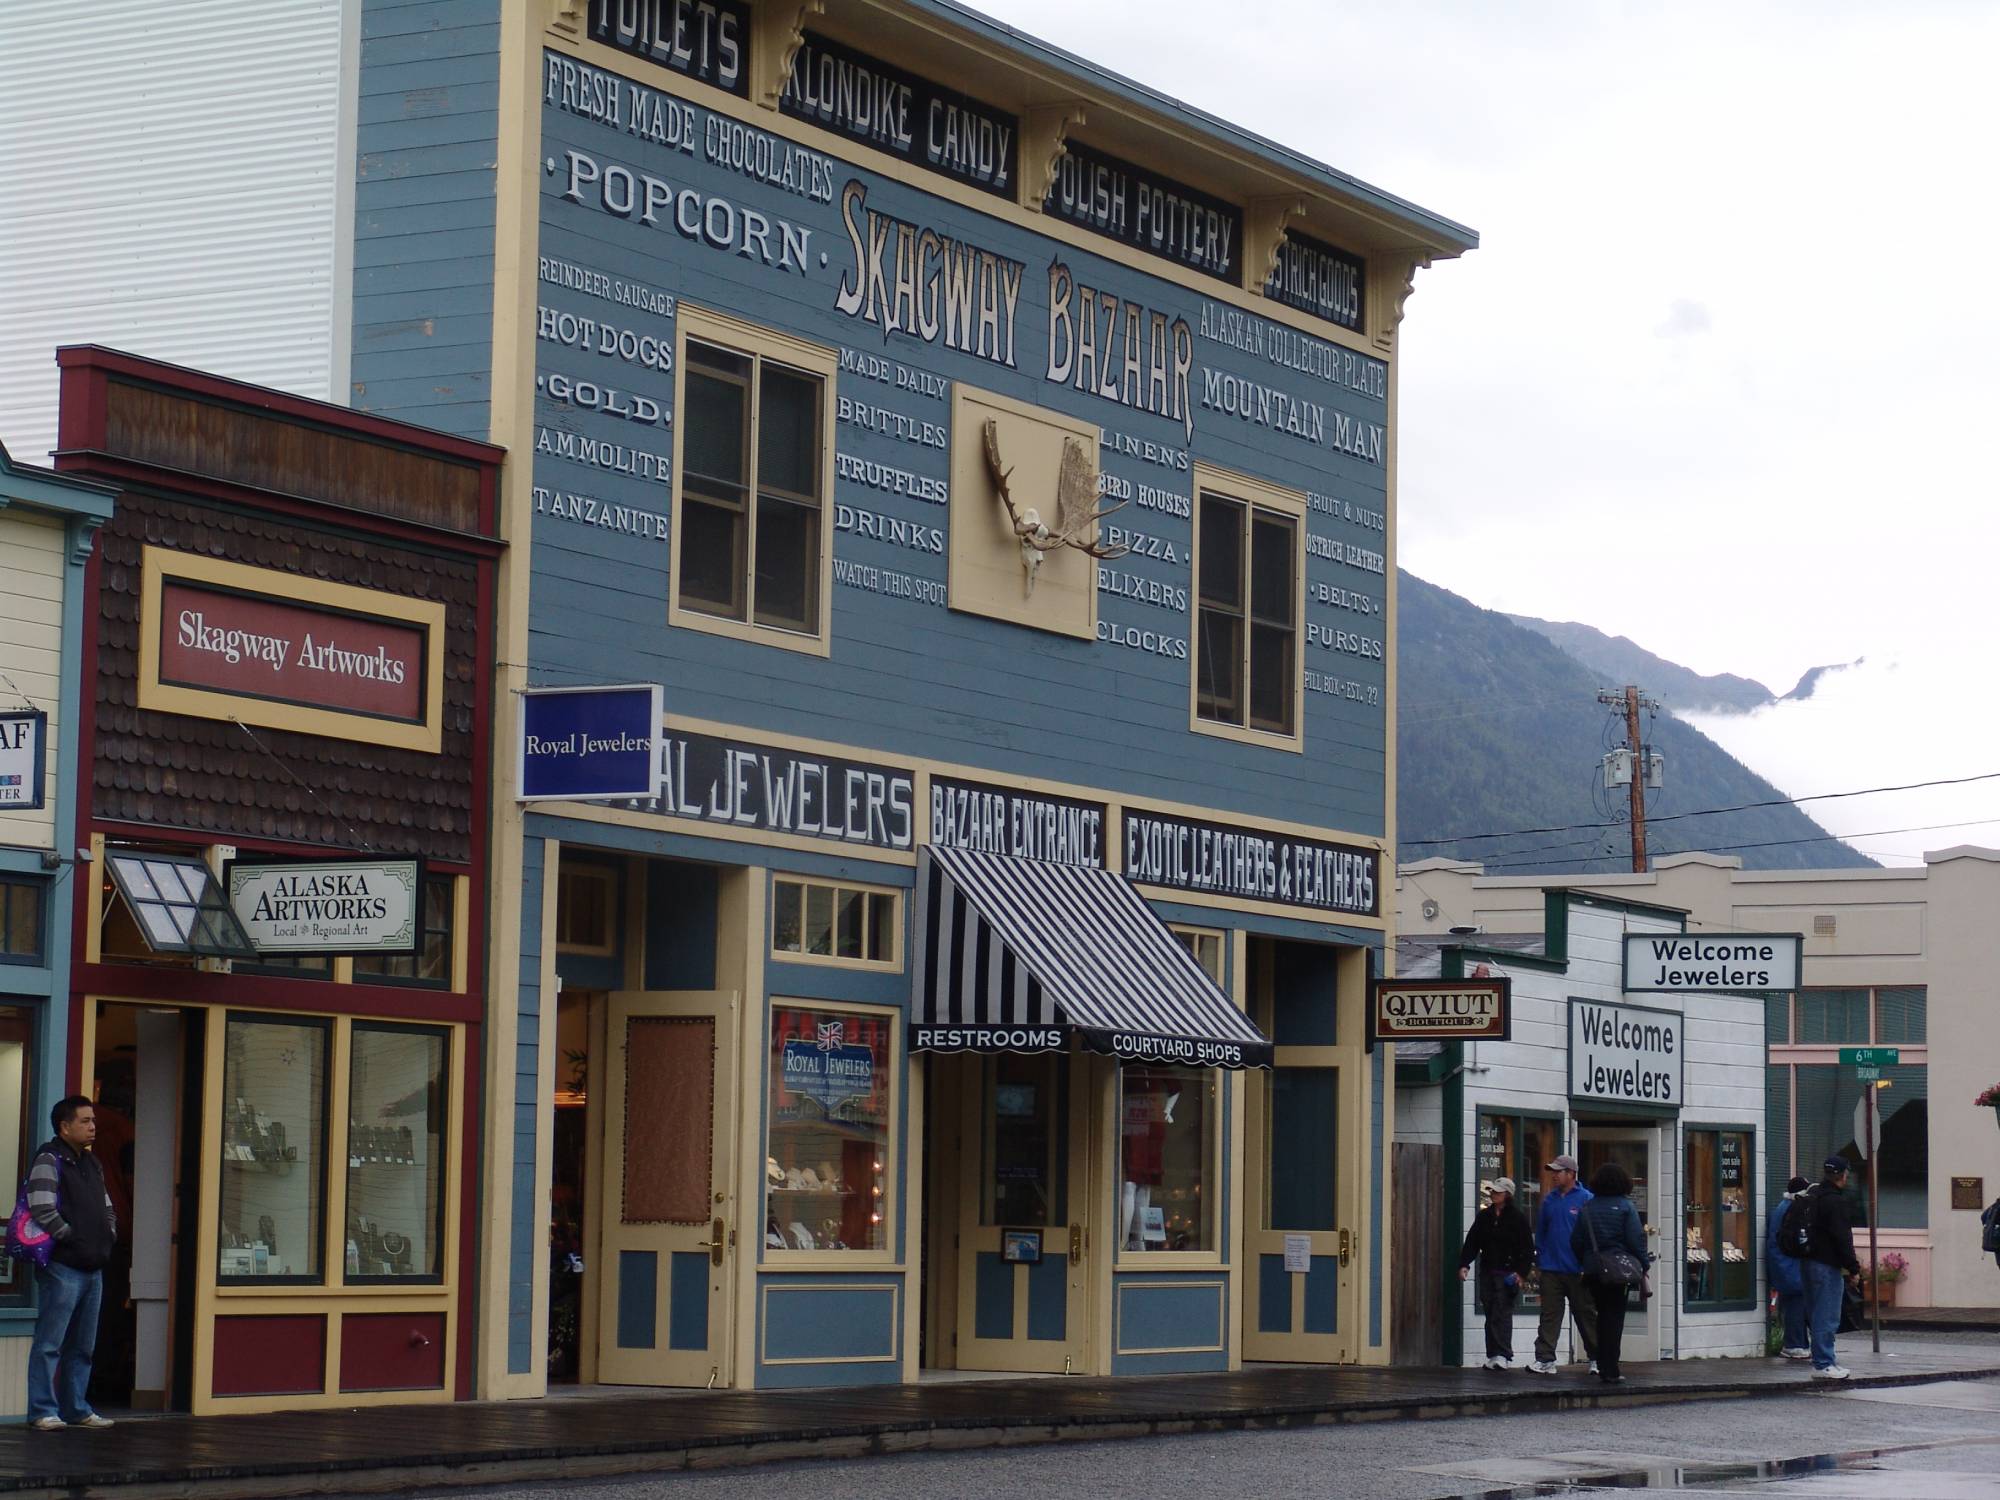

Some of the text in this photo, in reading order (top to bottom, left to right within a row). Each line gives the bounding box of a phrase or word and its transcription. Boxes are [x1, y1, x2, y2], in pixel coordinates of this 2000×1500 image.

[546, 53, 833, 203] FRESH MADE CHOCOLATES
[929, 98, 1011, 180] CANDY
[565, 150, 813, 271] POPCORN
[1137, 182, 1232, 267] POTTERY
[538, 256, 674, 318] REINDEER SAUSAGE
[1320, 254, 1357, 319] GOODS
[835, 178, 1194, 447] SKAGWAY BAZAAR
[538, 305, 672, 371] HOT DOGS
[1200, 301, 1384, 398] ALASKAN COLLECTOR PLATE
[839, 347, 948, 397] MADE DAILY
[838, 396, 946, 448] BRITTLES
[1202, 367, 1383, 462] MOUNTAIN MAN
[536, 428, 670, 481] AMMOLITE
[1100, 427, 1188, 470] LINENS
[836, 452, 948, 503] TRUFFLES
[533, 487, 668, 539] TANZANITE
[1137, 484, 1190, 518] HOUSES
[1306, 491, 1384, 530] FRUIT & NUTS
[836, 504, 943, 552] DRINKS
[1306, 533, 1384, 574] OSTRICH LEATHER
[832, 558, 947, 604] WATCH THIS SPOT
[1097, 567, 1186, 611] ELIXERS
[1318, 583, 1370, 613] BELTS
[178, 609, 405, 684] Skagway Artworks
[1096, 620, 1187, 659] CLOCKS
[1306, 622, 1381, 657] PURSES
[1304, 671, 1321, 690] PILL
[1324, 675, 1339, 695] BOX
[526, 732, 651, 758] Royal Jewelers
[710, 748, 912, 847] JEWELERS
[930, 783, 1101, 867] BAZAAR ENTRANCE
[1127, 816, 1373, 908] EXOTIC LEATHERS & FEATHERS
[251, 890, 386, 922] ARTWORKS
[273, 874, 370, 897] ALASKA
[273, 924, 297, 937] Local
[312, 923, 350, 940] Regional
[352, 922, 368, 936] Art
[1651, 939, 1774, 962] Welcome
[1654, 964, 1770, 986] Jewelers
[1386, 994, 1493, 1016] QIVIUT
[1409, 1017, 1471, 1025] BOUTIQUE
[916, 1029, 1062, 1047] RESTROOMS
[1112, 1033, 1242, 1062] COURTYARD SHOPS
[1580, 1005, 1674, 1055] Welcome
[786, 1049, 820, 1073] ROYAL
[1583, 1054, 1671, 1099] Jewelers
[1856, 1050, 1872, 1062] 6TH
